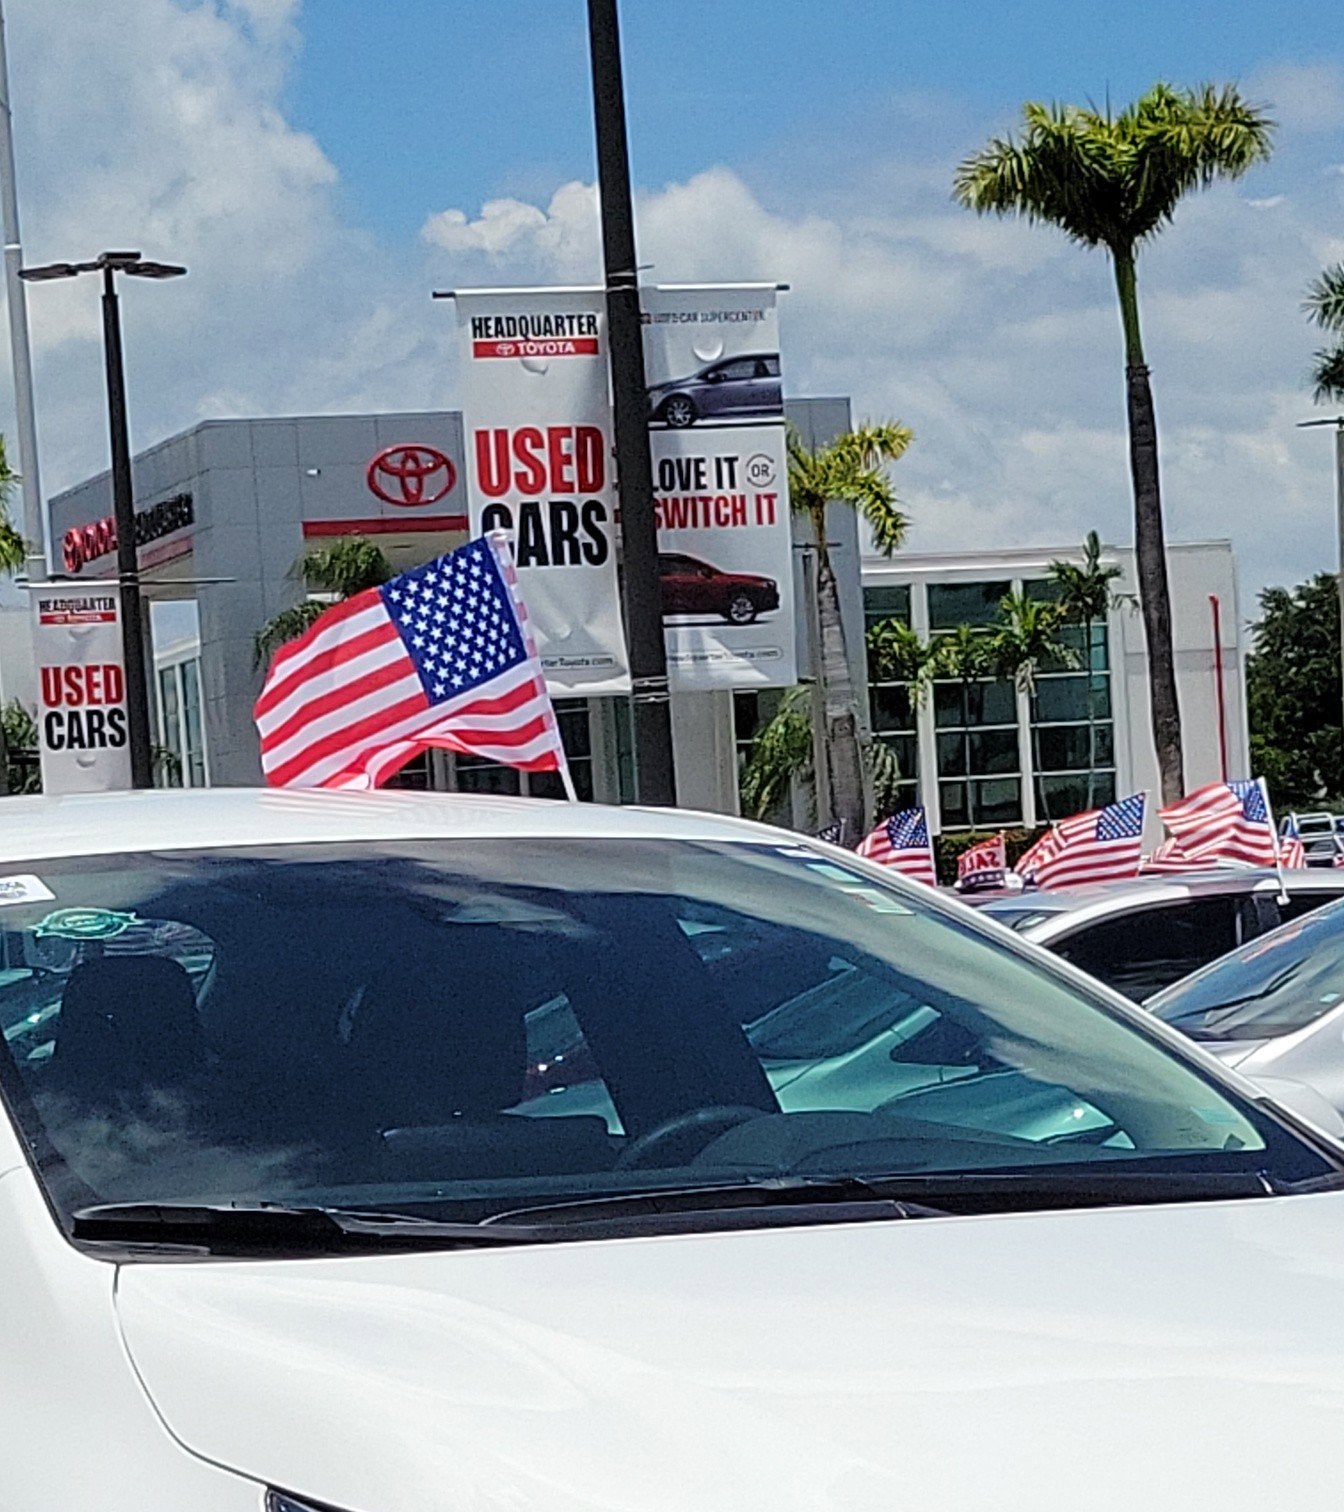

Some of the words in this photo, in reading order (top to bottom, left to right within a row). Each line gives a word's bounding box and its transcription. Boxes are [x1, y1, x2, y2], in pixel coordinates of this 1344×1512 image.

[471, 314, 598, 340] HEADQUARTER
[517, 341, 576, 355] TOYOTA
[474, 426, 605, 497] USED
[714, 456, 739, 490] IT
[750, 464, 770, 479] OR
[654, 494, 747, 530] SWITCH
[755, 493, 778, 526] IT
[39, 598, 116, 614] HEADQUARTER
[41, 664, 124, 708] USED
[45, 708, 127, 750] CARS
